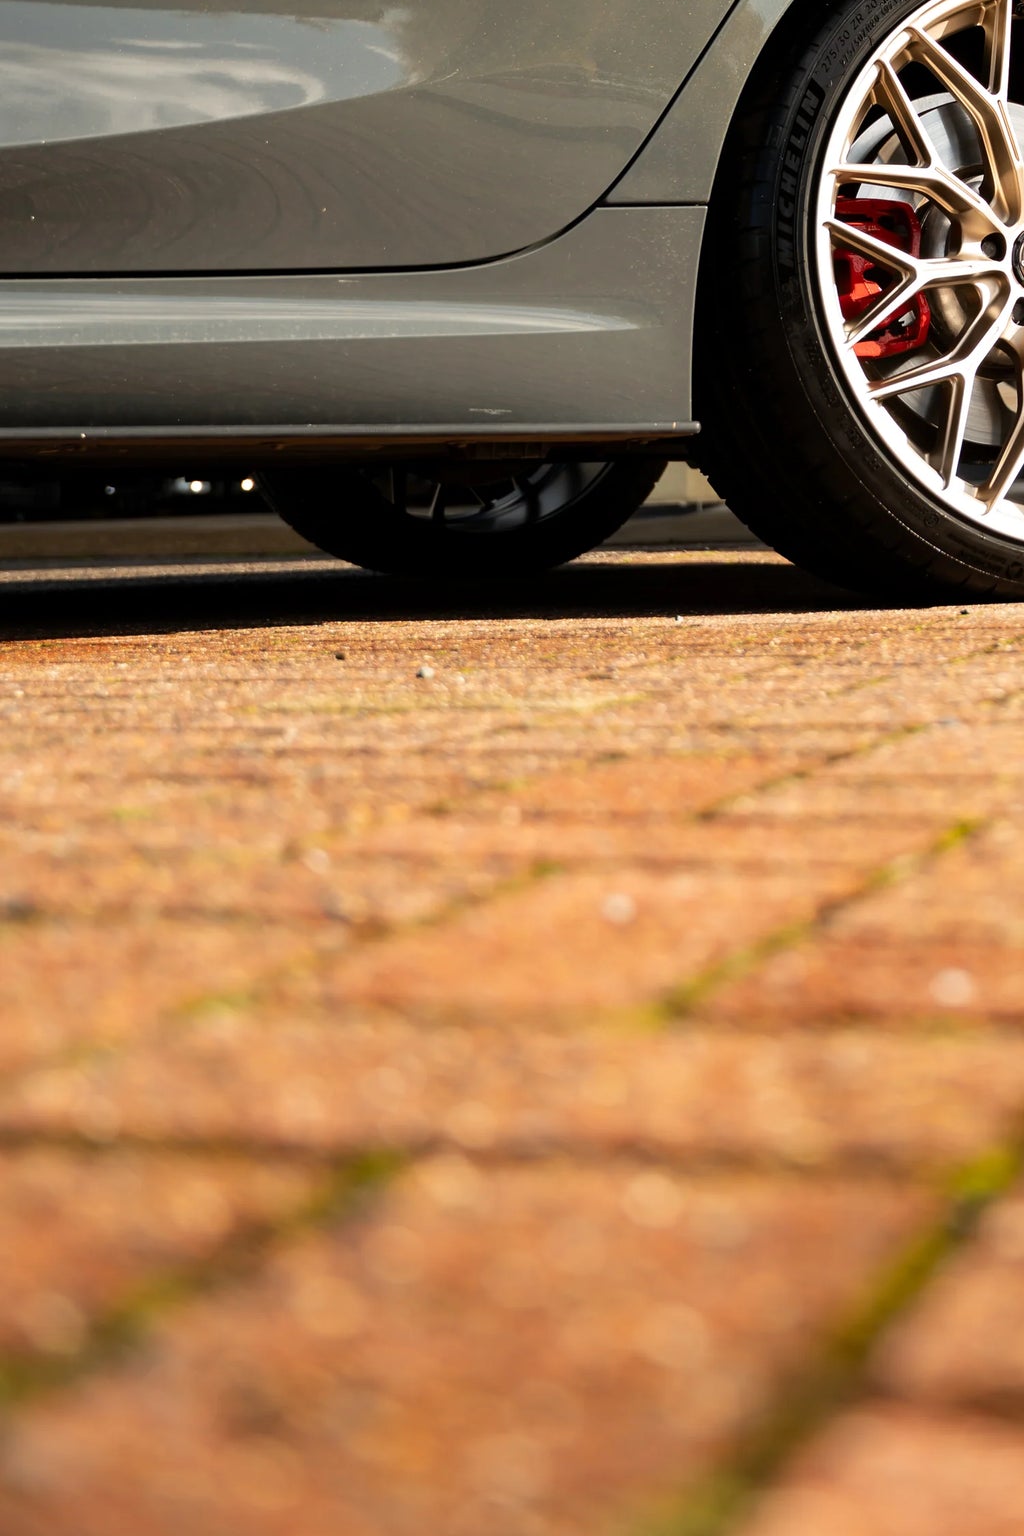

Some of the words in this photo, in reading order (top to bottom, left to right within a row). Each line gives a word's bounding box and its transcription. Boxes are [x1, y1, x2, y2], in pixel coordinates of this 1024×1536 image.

[821, 30, 850, 72] 275/30
[850, 13, 864, 30] ZR
[777, 88, 820, 268] MICHELIN
